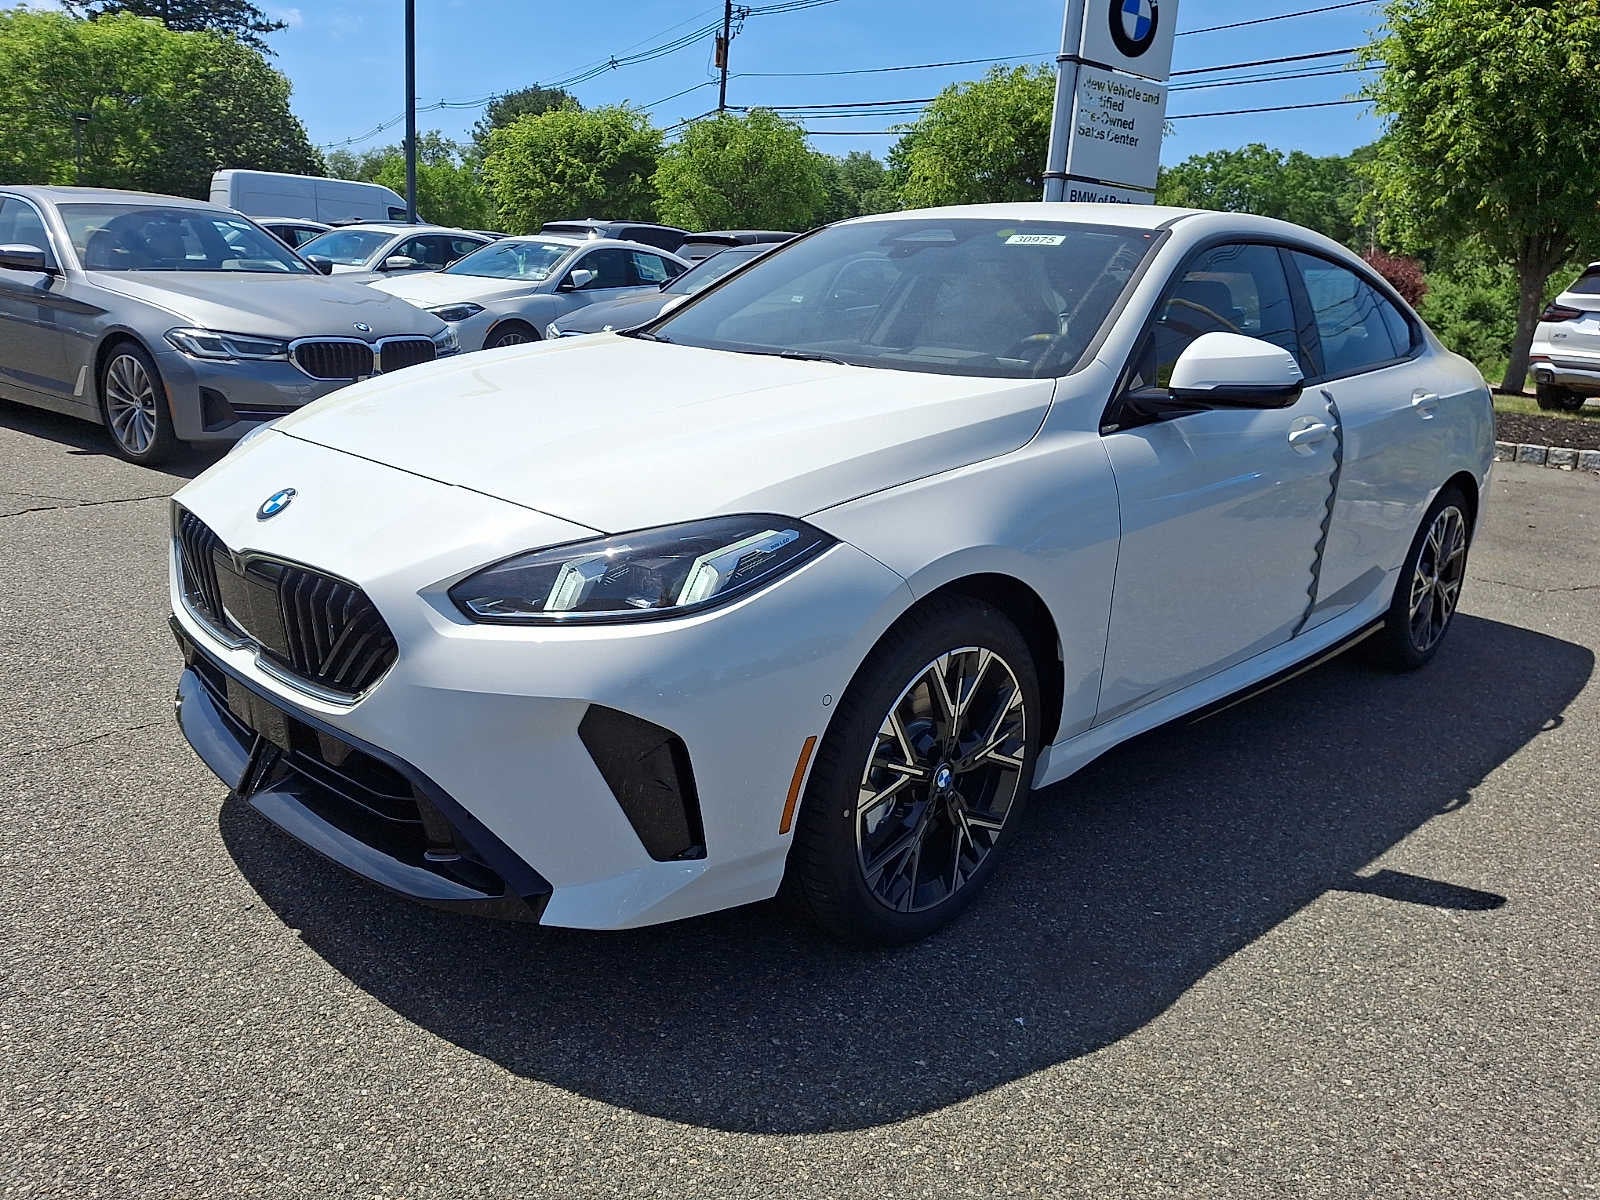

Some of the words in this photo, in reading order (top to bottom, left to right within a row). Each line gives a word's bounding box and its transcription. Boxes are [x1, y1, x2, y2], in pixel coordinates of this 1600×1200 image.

[1107, 80, 1141, 100] Vehicle
[1142, 92, 1160, 104] and
[1080, 108, 1135, 130] e-Owned
[1078, 125, 1105, 140] Sales
[1107, 128, 1139, 147] Center
[1070, 189, 1097, 202] BMW
[1098, 195, 1108, 203] of
